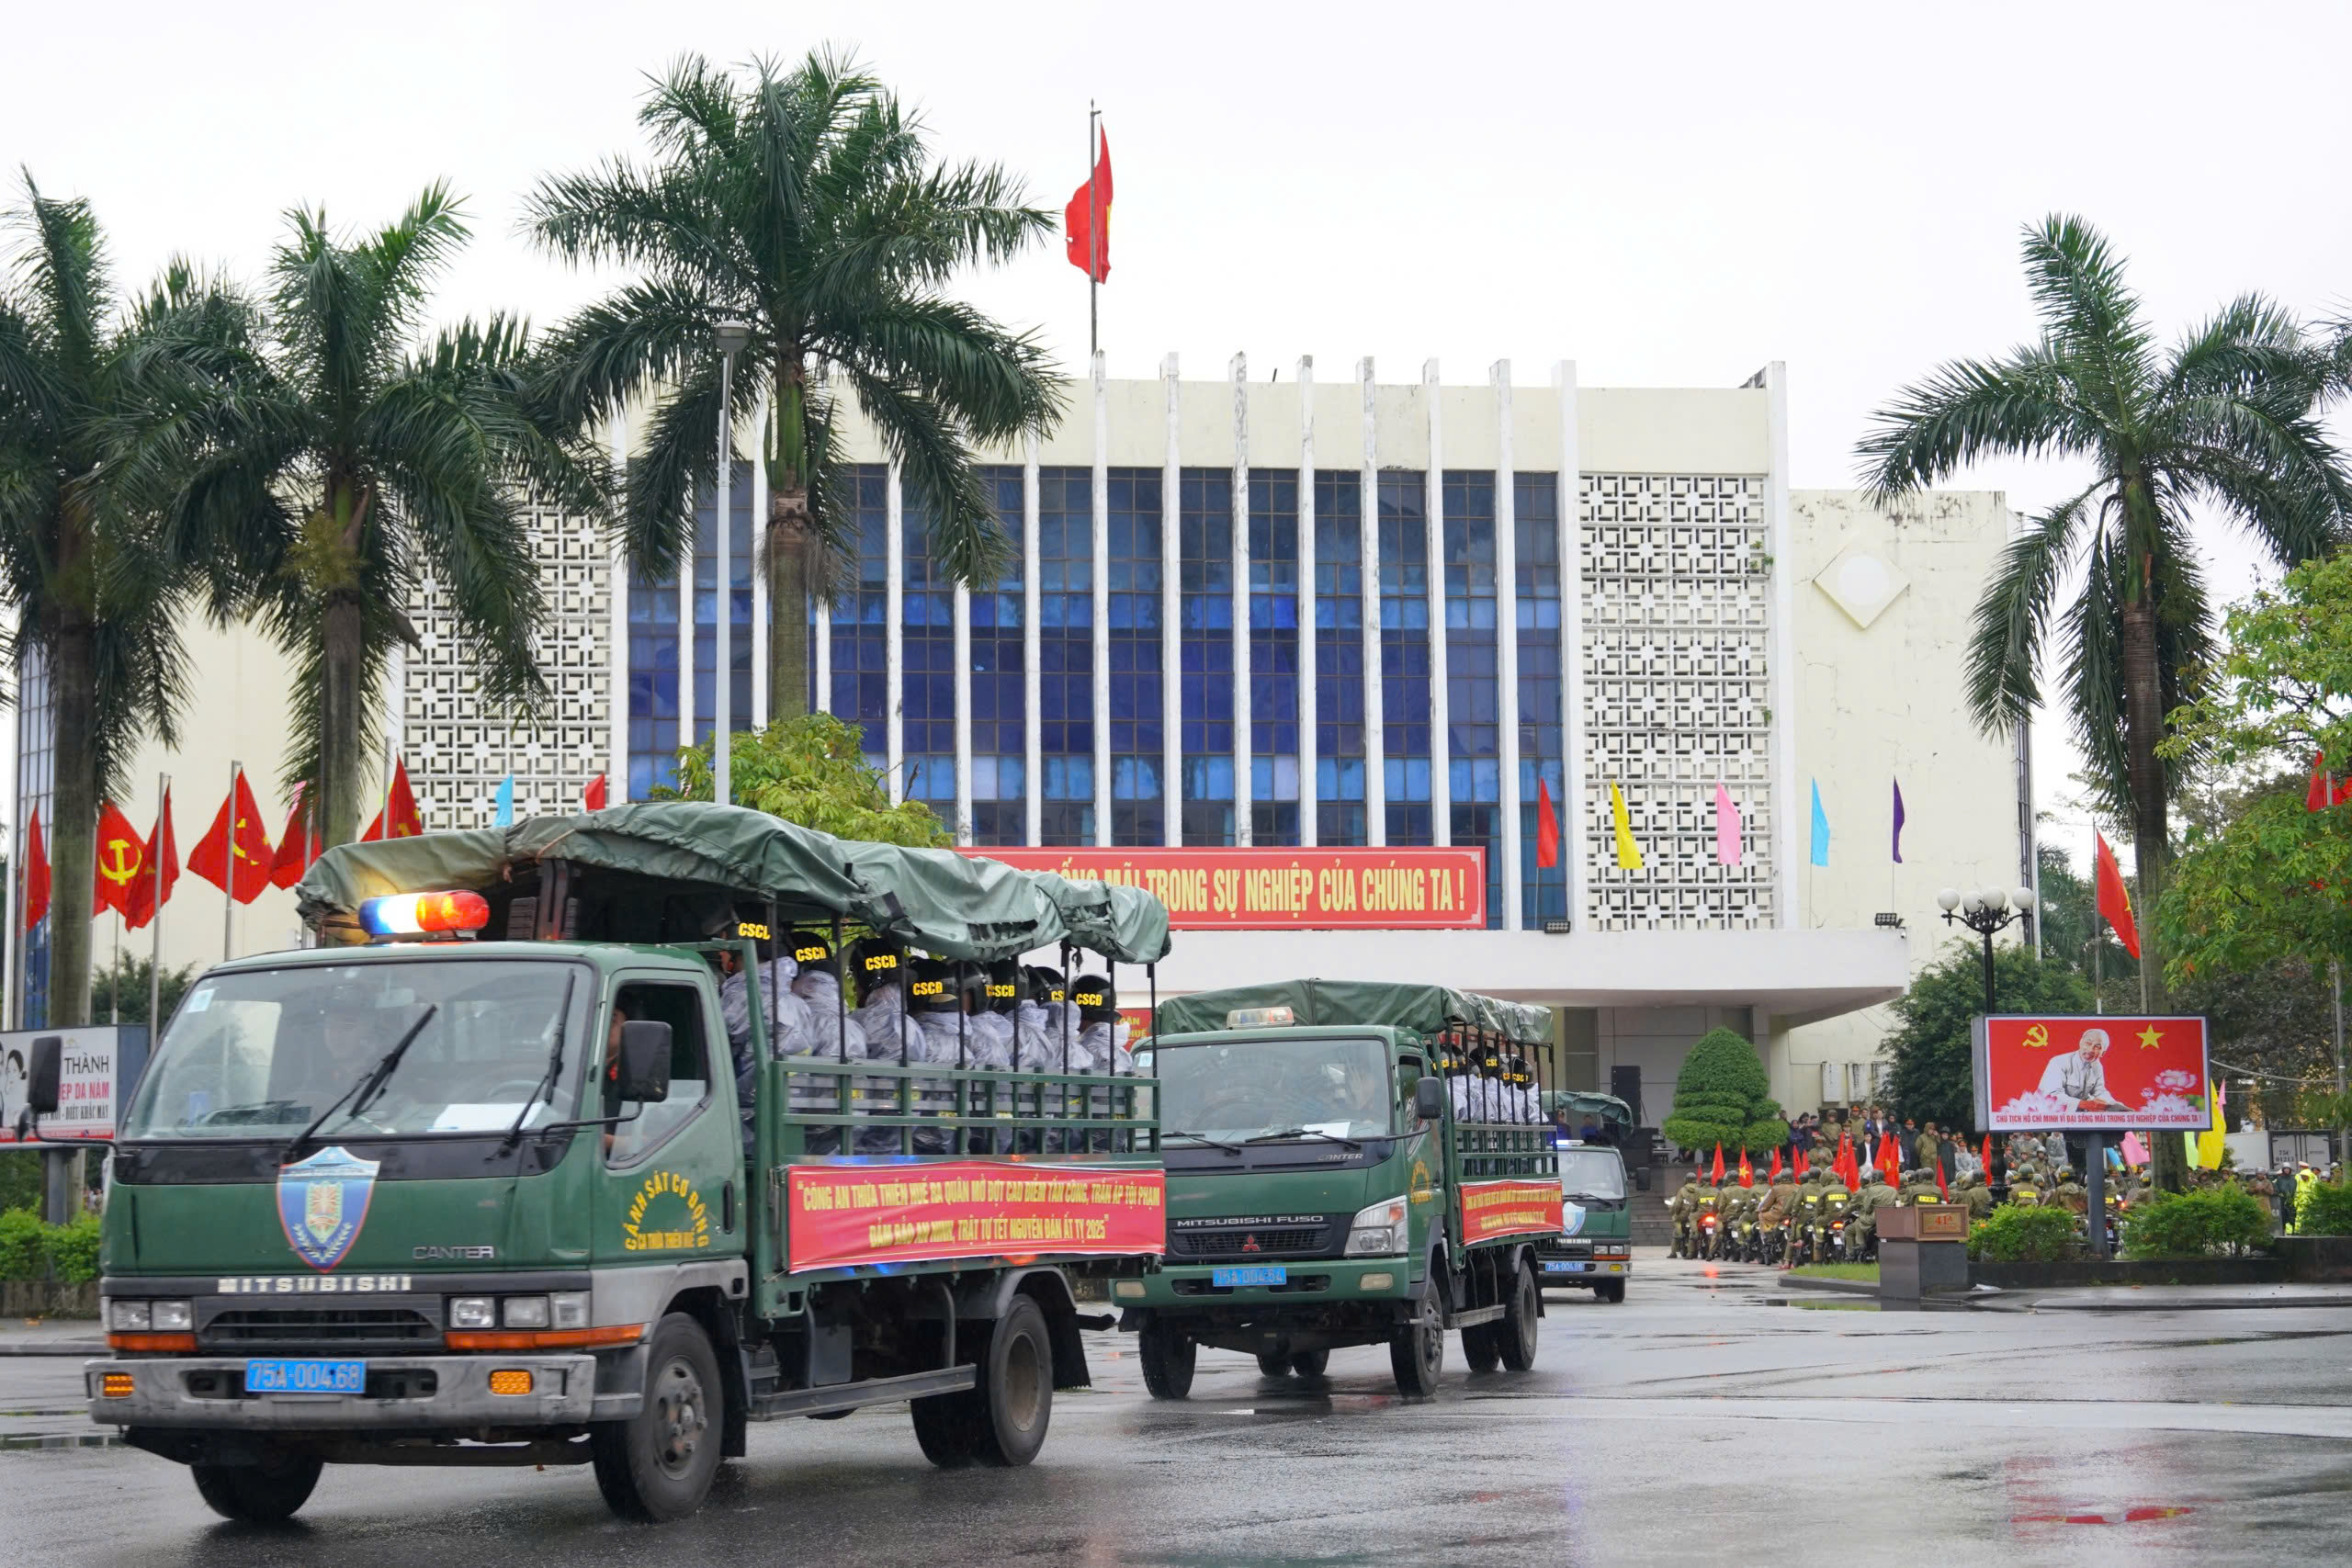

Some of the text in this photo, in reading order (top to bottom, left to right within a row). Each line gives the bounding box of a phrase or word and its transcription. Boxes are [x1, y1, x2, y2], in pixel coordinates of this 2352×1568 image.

[1146, 869, 1207, 912] TRONG
[1213, 869, 1239, 919] SỰ
[1245, 861, 1313, 919] NGHIỆP
[1319, 858, 1356, 912] CỦA
[1362, 860, 1425, 912] CHÚNG
[1430, 869, 1453, 911] TA
[63, 1052, 109, 1075] THÀNH
[1318, 1153, 1363, 1161] CANTER
[1177, 1215, 1324, 1227] MITSUBISHI FUSO
[413, 1246, 494, 1259] CANTER
[218, 1276, 413, 1293] MITSUBISHI
